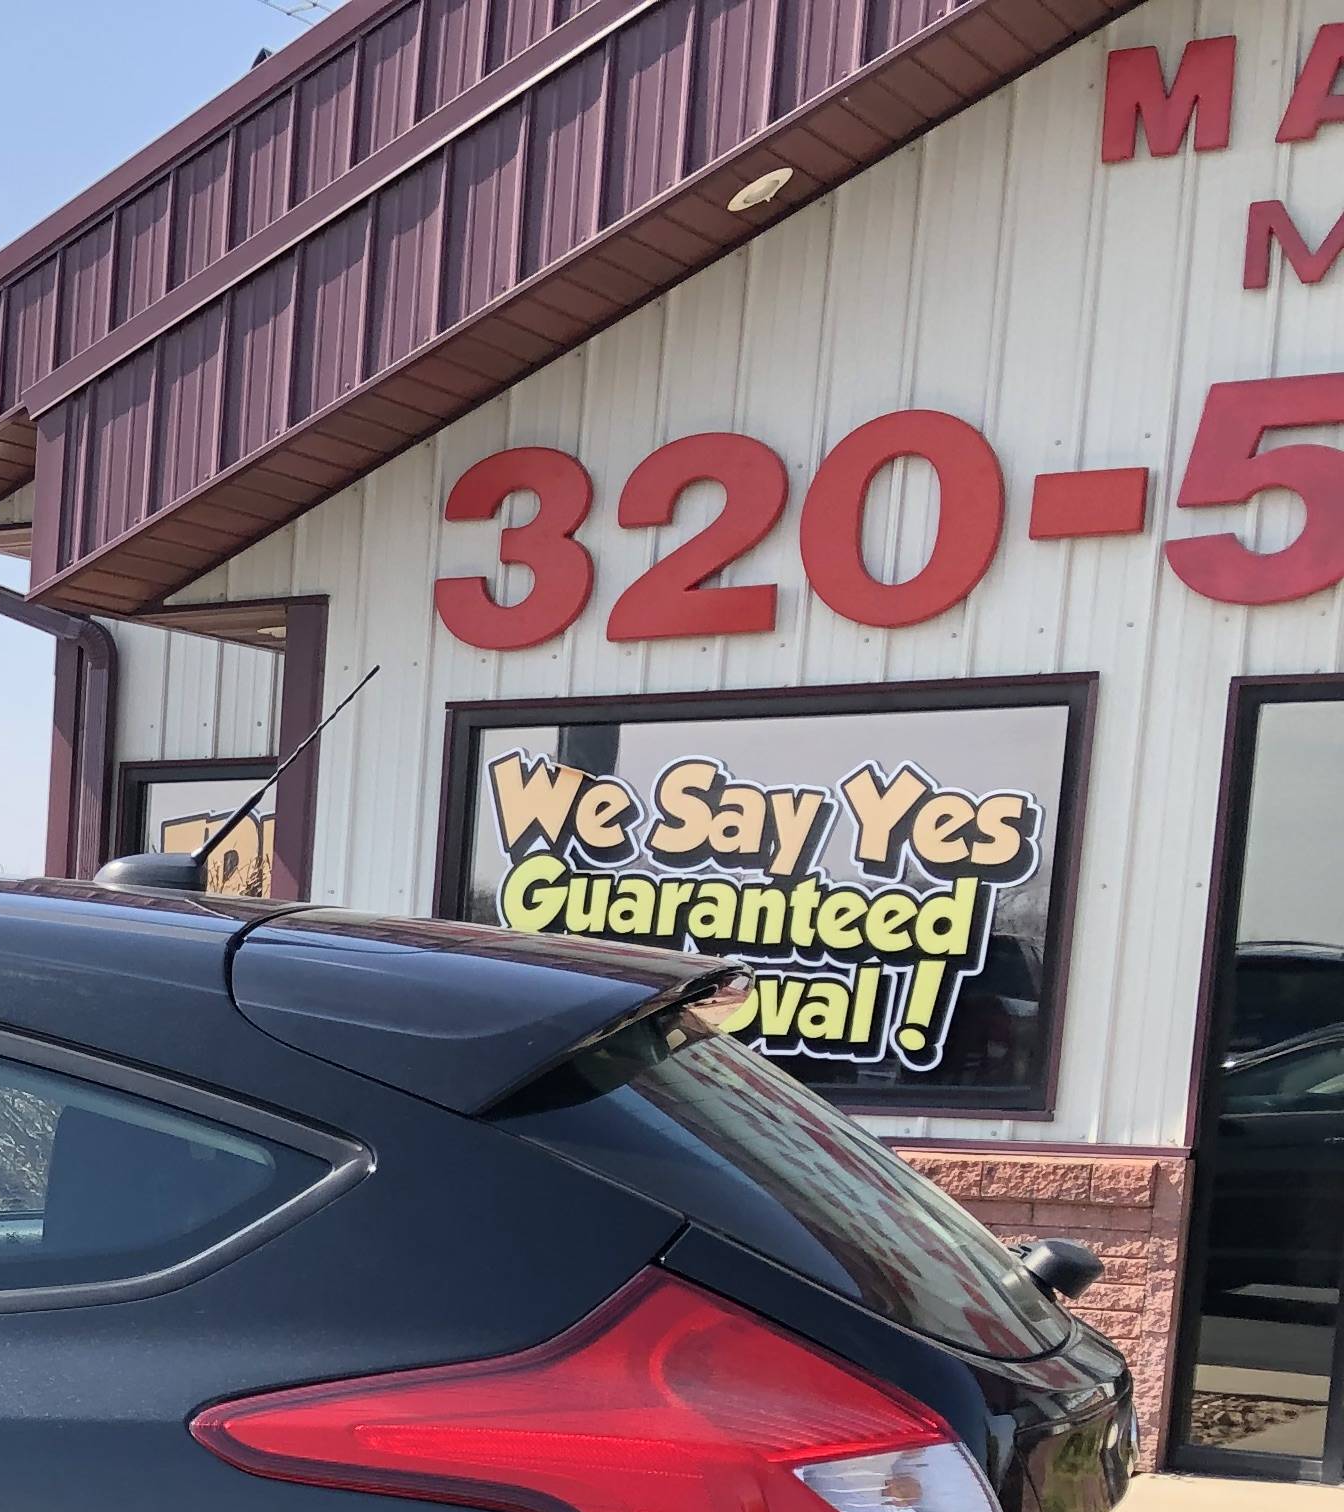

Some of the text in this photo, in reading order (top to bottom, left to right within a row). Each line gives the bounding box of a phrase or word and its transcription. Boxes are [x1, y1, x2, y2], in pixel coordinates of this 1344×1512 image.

[433, 374, 1344, 651] 320-5
[490, 750, 1036, 880] We Say Yes
[500, 852, 988, 966] Guaranteed
